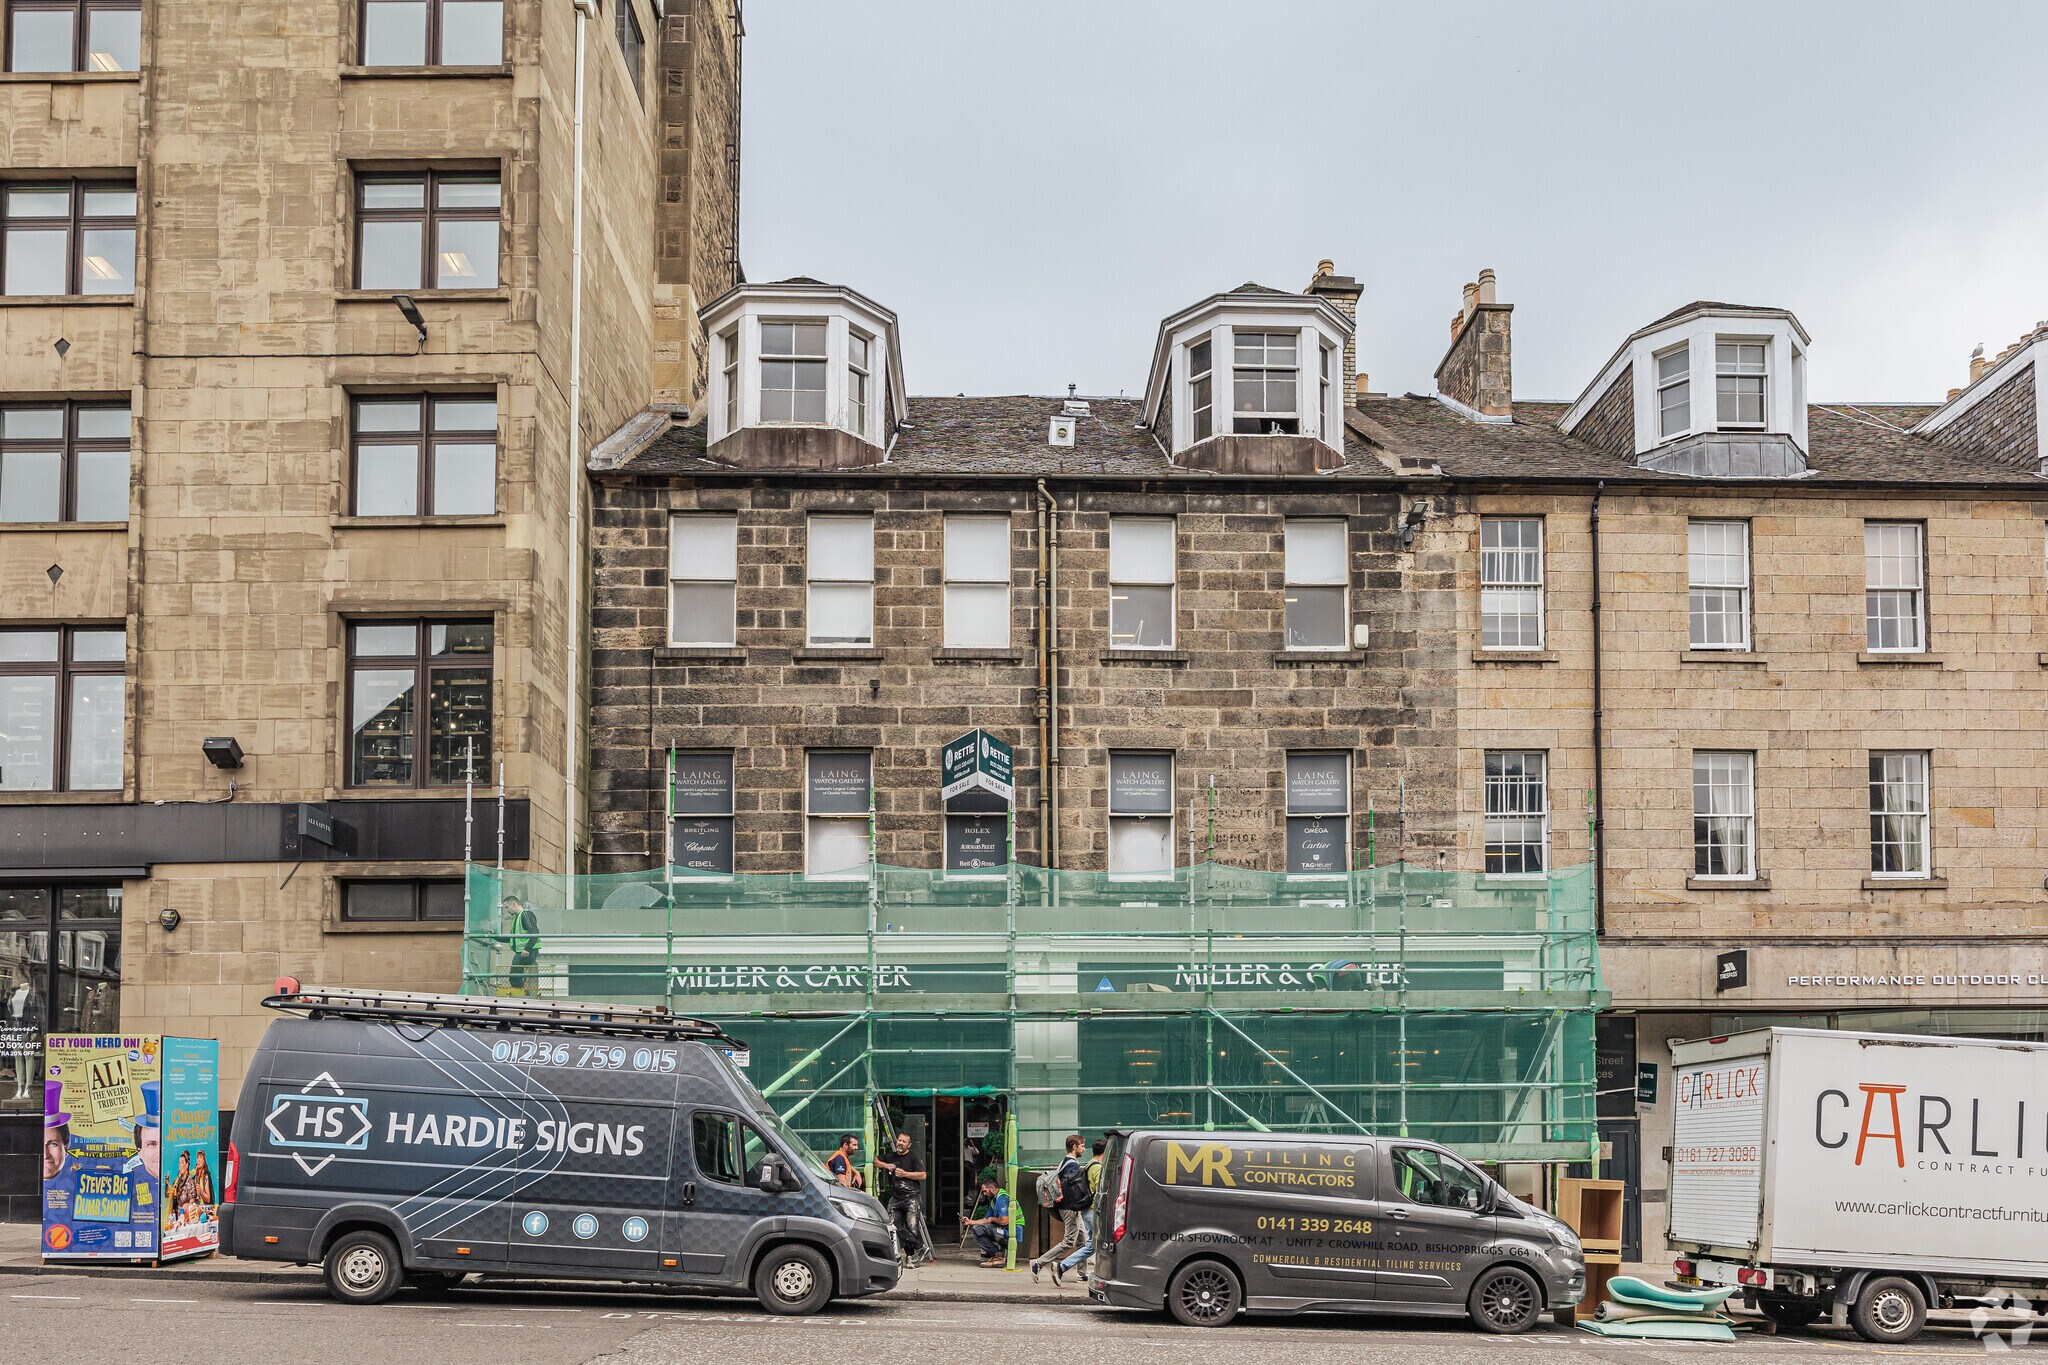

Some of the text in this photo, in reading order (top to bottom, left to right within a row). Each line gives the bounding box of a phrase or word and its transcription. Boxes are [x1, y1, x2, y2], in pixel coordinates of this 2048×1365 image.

[954, 742, 975, 762] RETTIE
[989, 746, 1010, 765] RETTIE
[683, 771, 721, 780] LAING
[821, 770, 859, 779] LAING
[1122, 771, 1160, 780] LAING
[1297, 771, 1334, 780] LAING
[949, 785, 959, 794] FOR
[959, 780, 970, 789] SALE
[985, 777, 1006, 793] FOR SALE
[684, 841, 719, 853] Chopard
[1301, 840, 1331, 849] Cartier
[669, 965, 770, 988] MILLER
[776, 965, 800, 988] &
[1174, 963, 1410, 986] MILLER & CTER
[1788, 975, 1926, 986] PERFORMANCE
[1931, 975, 2021, 985] OUTDOOR
[49, 1037, 140, 1048] GET YOUR NERD ON!
[491, 1039, 677, 1073] 01236 759 015
[92, 1059, 126, 1091] AL!
[92, 1086, 130, 1100] THE WEIRD
[1681, 1067, 1759, 1109] CARLICK
[97, 1096, 129, 1109] TRIBUTE!
[295, 1104, 346, 1138] HS
[1816, 1083, 2048, 1168] CARLI
[385, 1111, 646, 1157] HARDIE SIGNS
[1678, 1146, 1756, 1162] 0161 727 3090
[1166, 1141, 1355, 1187] MR TILING
[1917, 1160, 2015, 1175] CONTRACT
[79, 1173, 129, 1195] STEVE'S BIG
[1244, 1170, 1355, 1188] CONTRACTORS
[75, 1195, 99, 1217] DUMB
[101, 1197, 131, 1218] SHOW!
[1257, 1216, 1372, 1234] 0141 339 2648
[1130, 1231, 1530, 1257] VISIT OUR SHOWROOM AT UNIT 2 CROWHILL ROAD, BISHOPBRIGGS G64
[1253, 1254, 1462, 1272] COMMERCIAL & RESIDENTIAL TILING SERVICES
